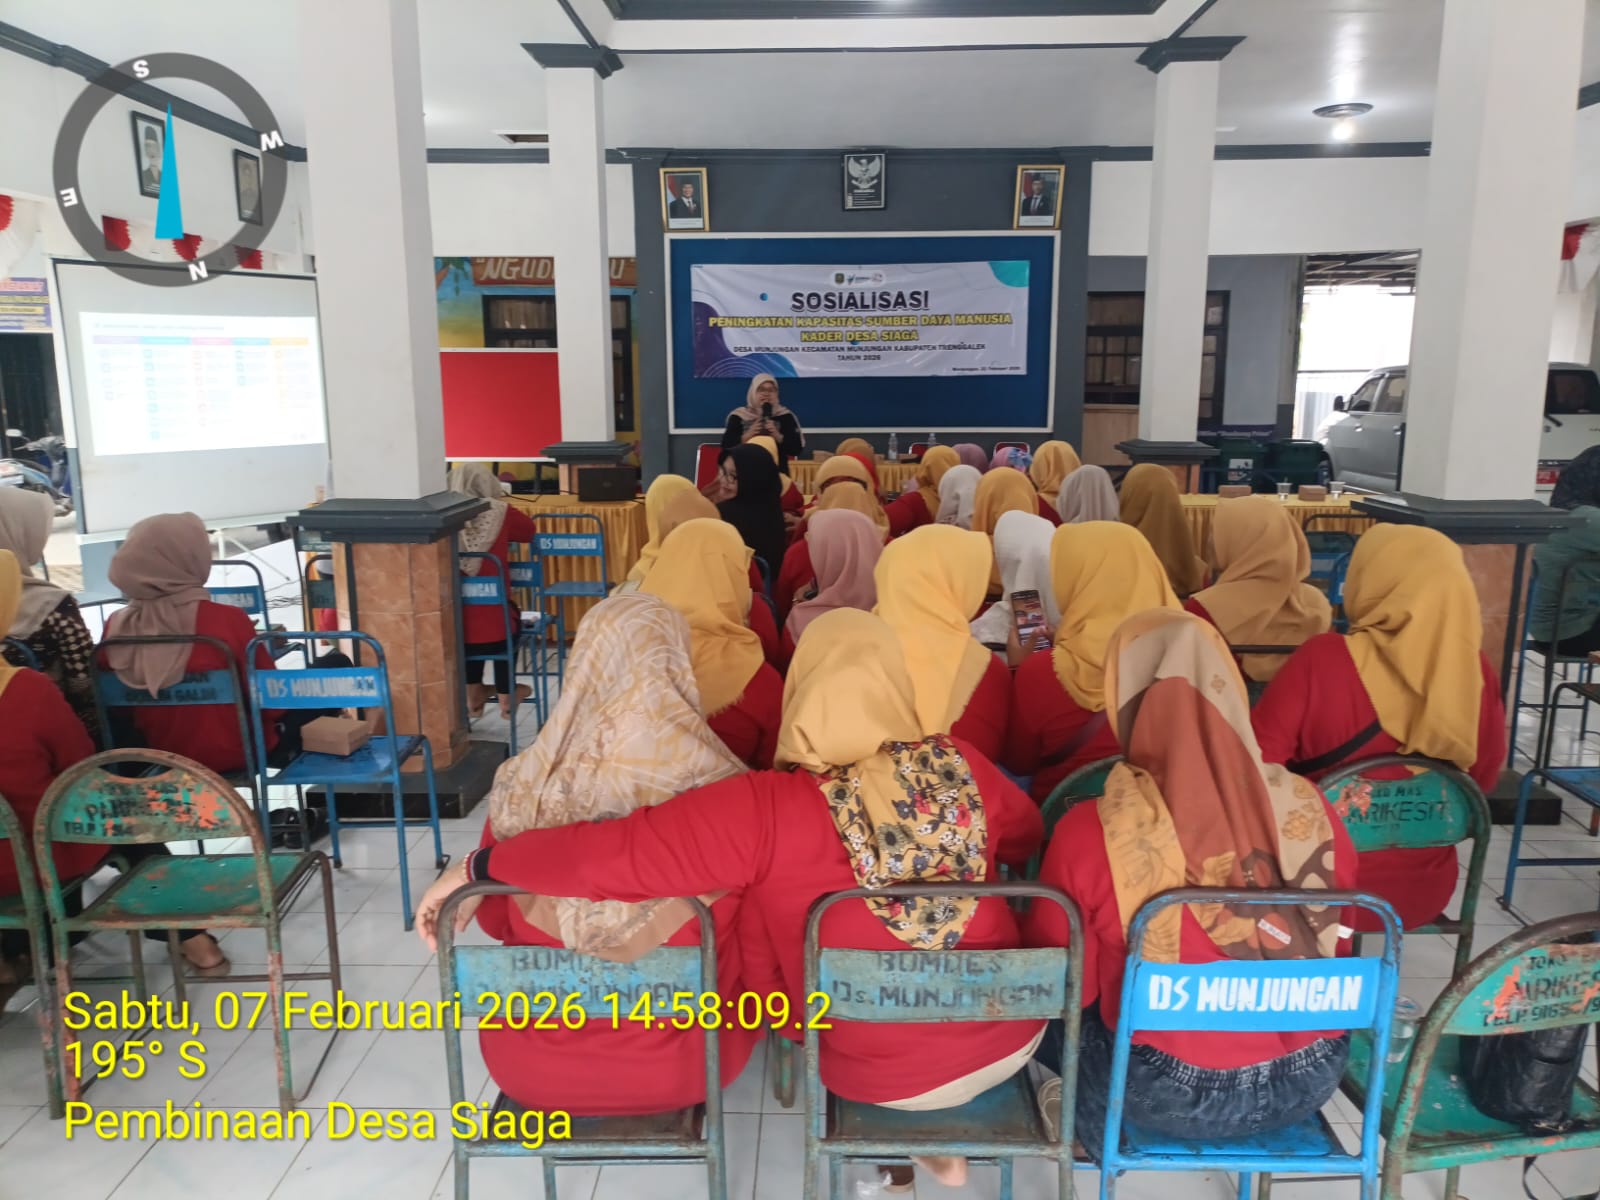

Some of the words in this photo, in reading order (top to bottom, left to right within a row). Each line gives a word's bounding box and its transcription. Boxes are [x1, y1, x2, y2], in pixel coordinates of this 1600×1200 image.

[708, 316, 793, 328] PENINGKATAN
[796, 316, 863, 327] KAPASITAS
[866, 315, 918, 326] SUMBER
[921, 314, 952, 326] DAYA
[955, 313, 1013, 325] MANUSIA
[801, 331, 842, 343] KADER
[846, 331, 878, 342] DESA
[881, 330, 919, 341] SIAGA
[1149, 975, 1191, 1011] DS
[1196, 975, 1362, 1012] MUNJUNGAN
